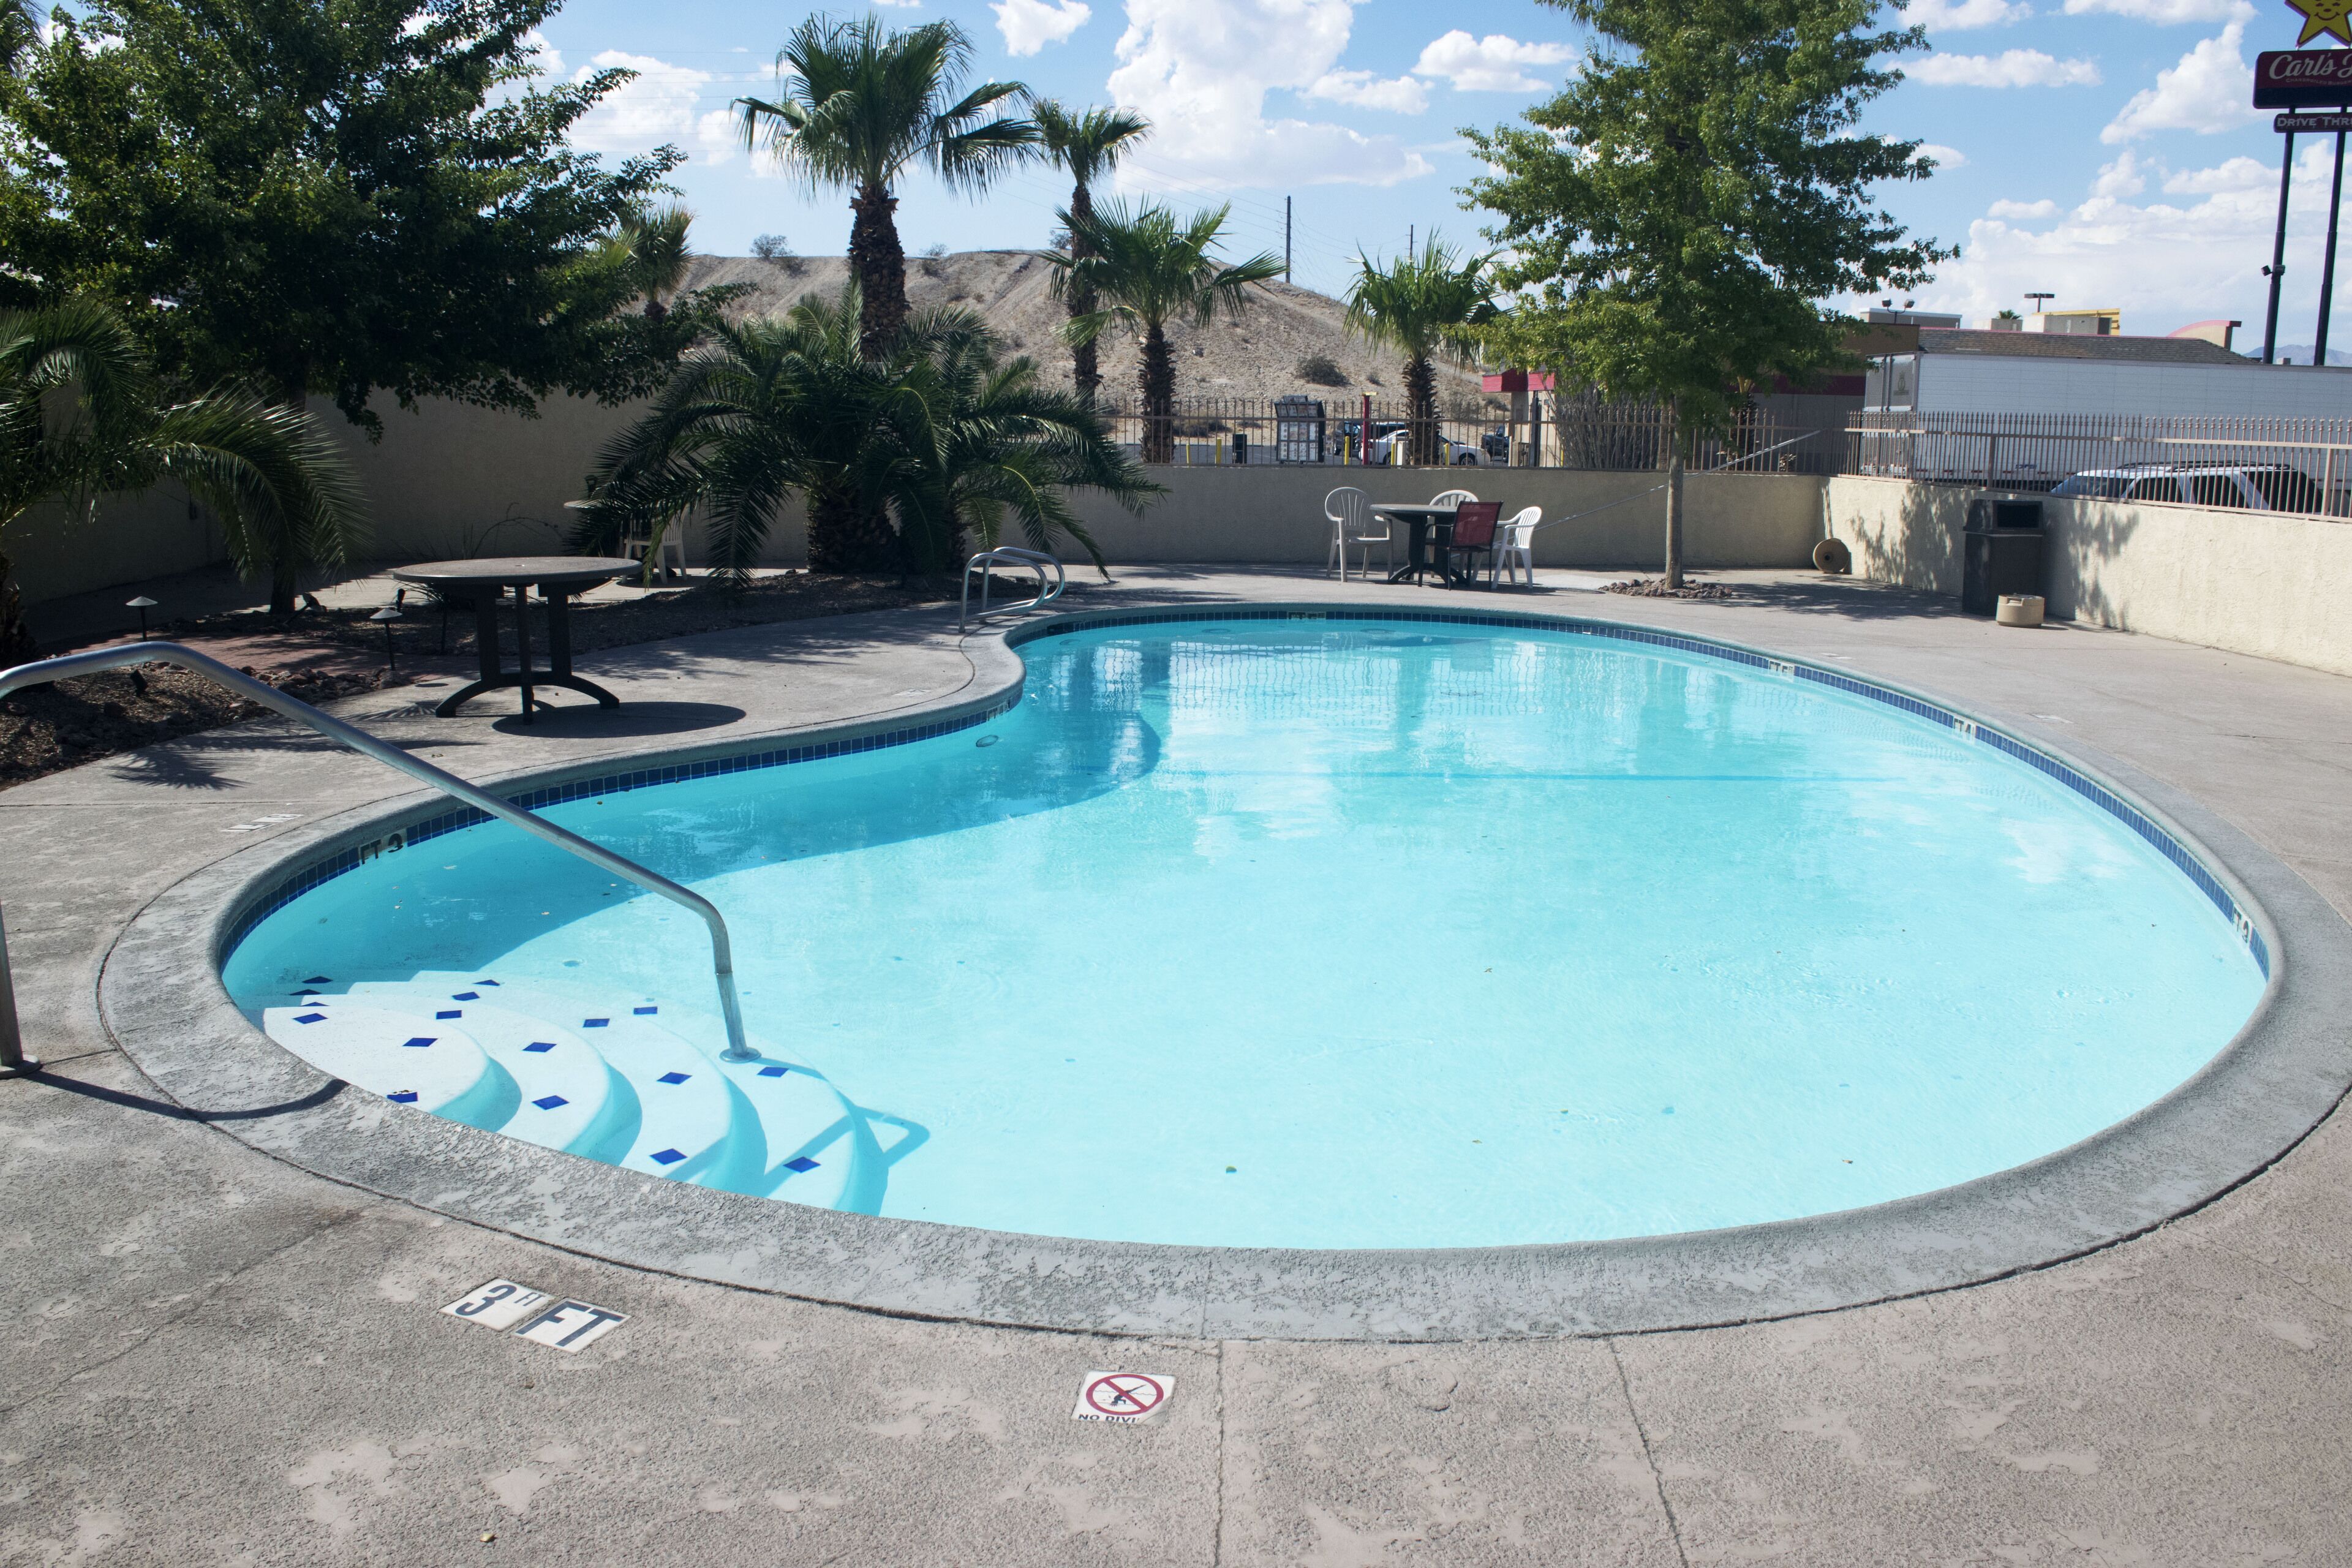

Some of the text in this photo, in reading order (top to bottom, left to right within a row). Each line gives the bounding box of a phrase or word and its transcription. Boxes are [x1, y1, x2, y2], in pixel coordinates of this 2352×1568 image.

[2269, 53, 2337, 80] Carl's
[2277, 117, 2317, 127] DRIVE
[455, 1284, 625, 1347] 3 FT FT
[1105, 1415, 1140, 1423] DIVI
